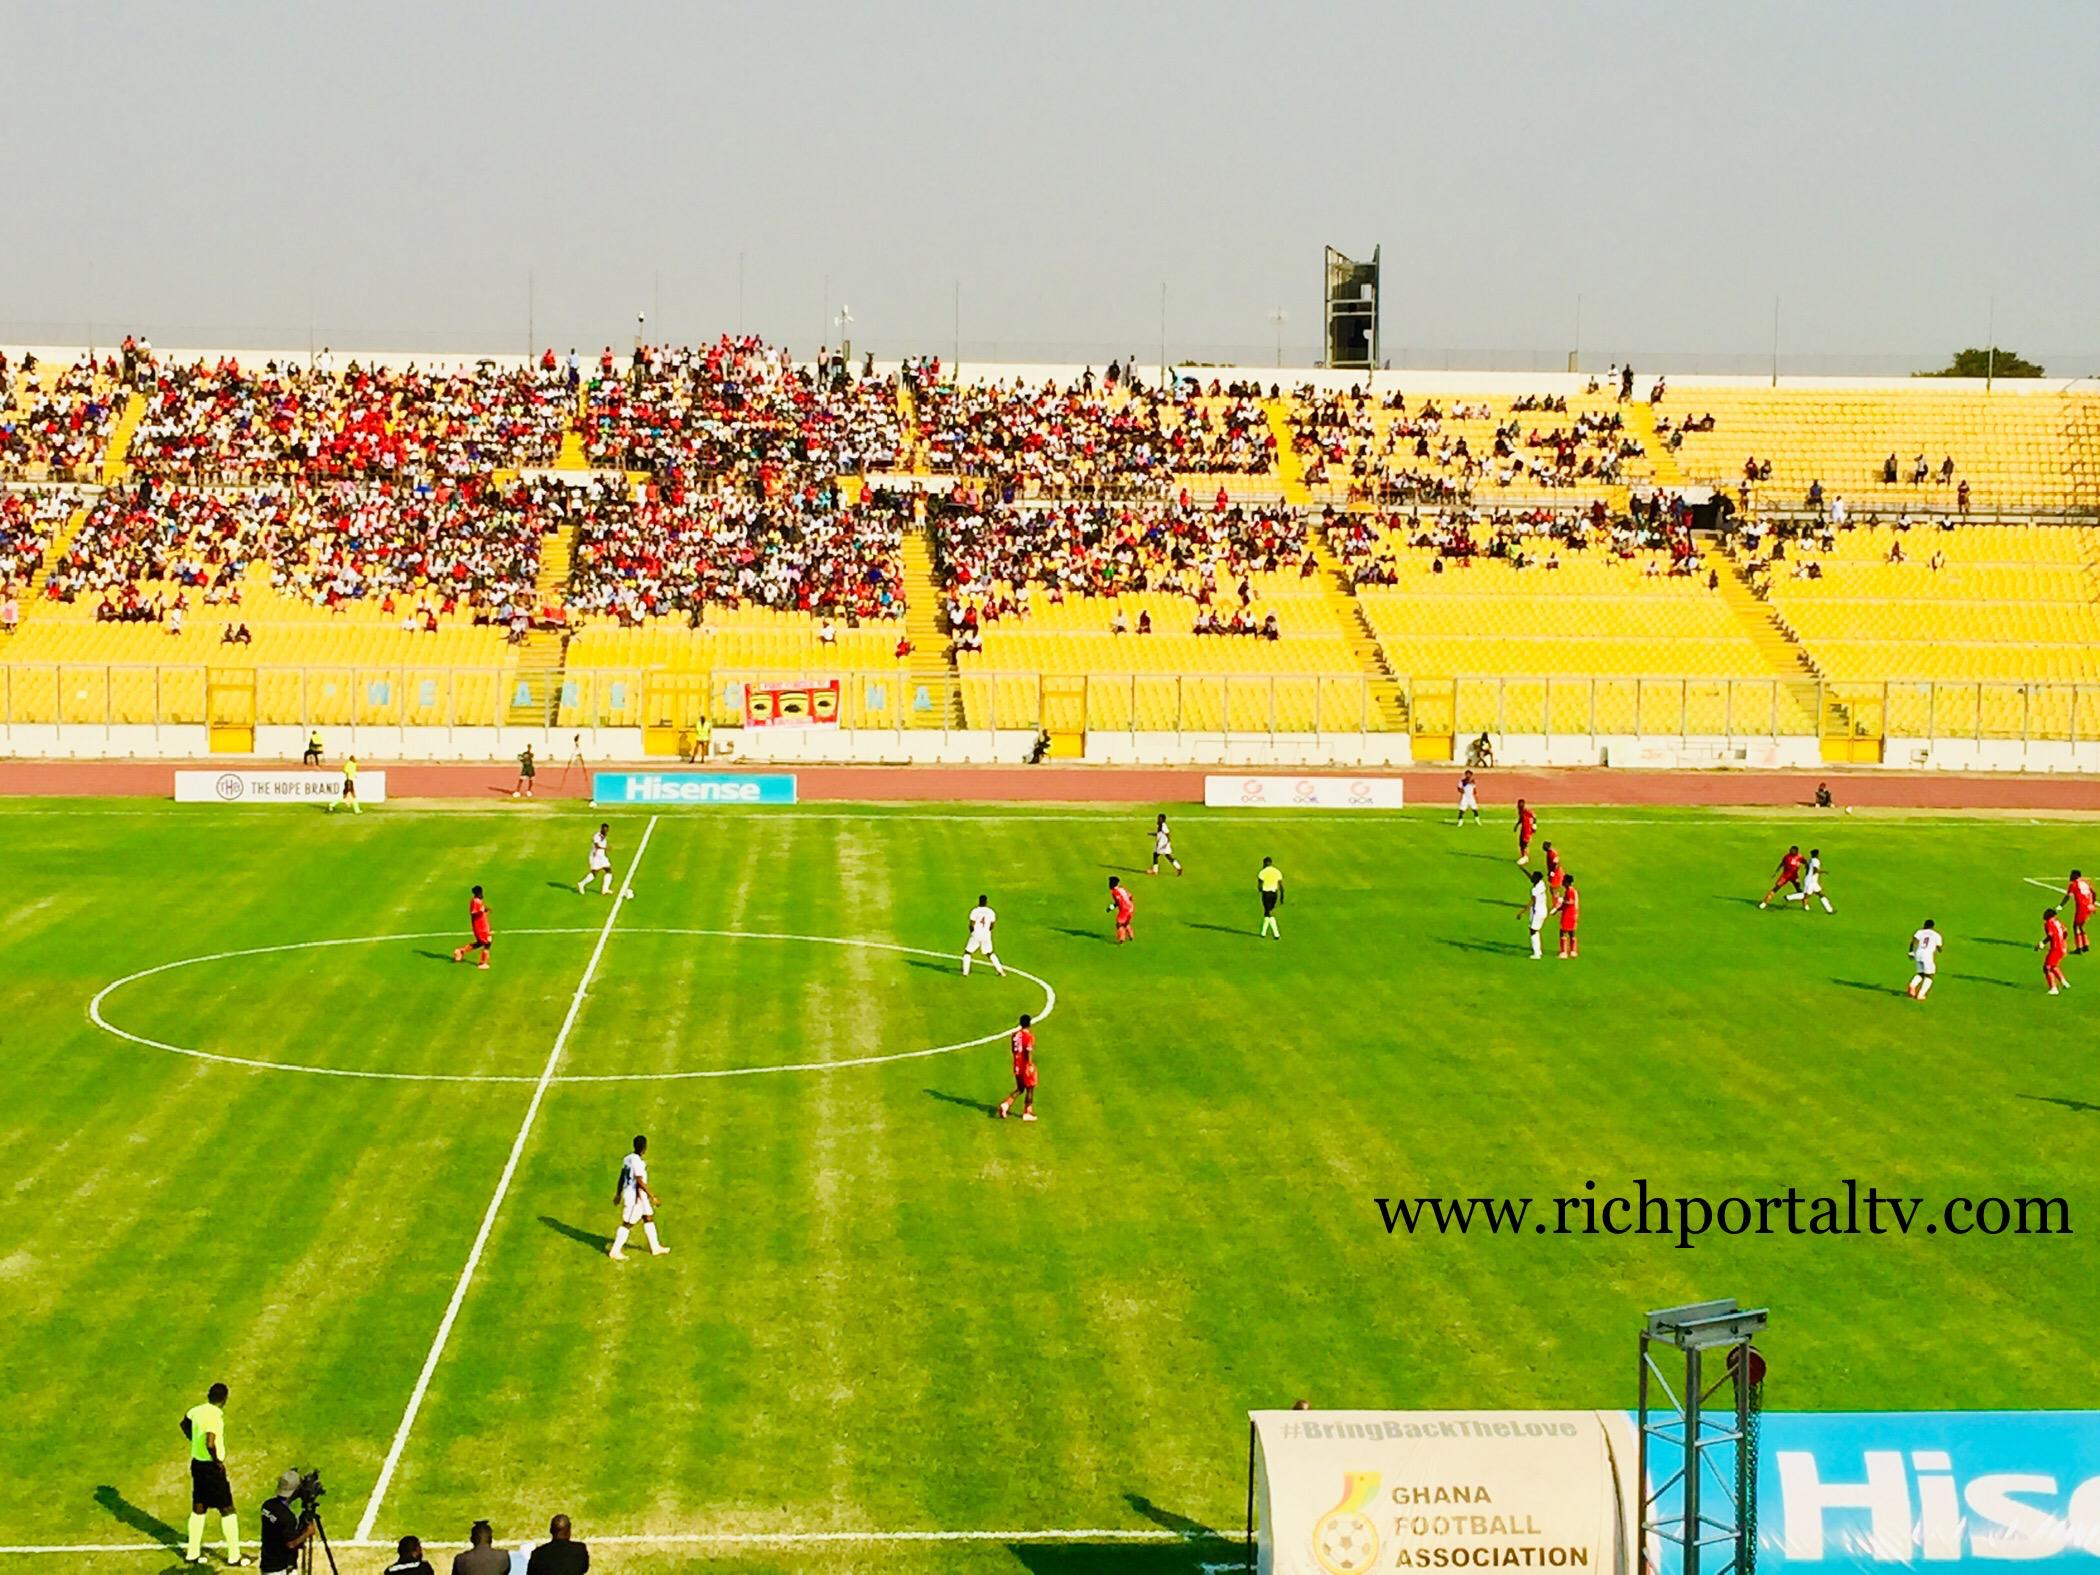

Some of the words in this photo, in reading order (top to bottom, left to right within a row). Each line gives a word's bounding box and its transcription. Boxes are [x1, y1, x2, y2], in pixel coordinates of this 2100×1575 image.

[251, 782, 270, 795] THE
[274, 782, 300, 795] HOPE
[305, 782, 339, 795] BRAND
[626, 776, 760, 801] Hisense
[1283, 1420, 1577, 1441] #BringBackTheLove
[1392, 1486, 1492, 1505] GHANA
[1394, 1514, 1541, 1536] FOOTBALL
[1395, 1547, 1588, 1569] ASSOCIATION
